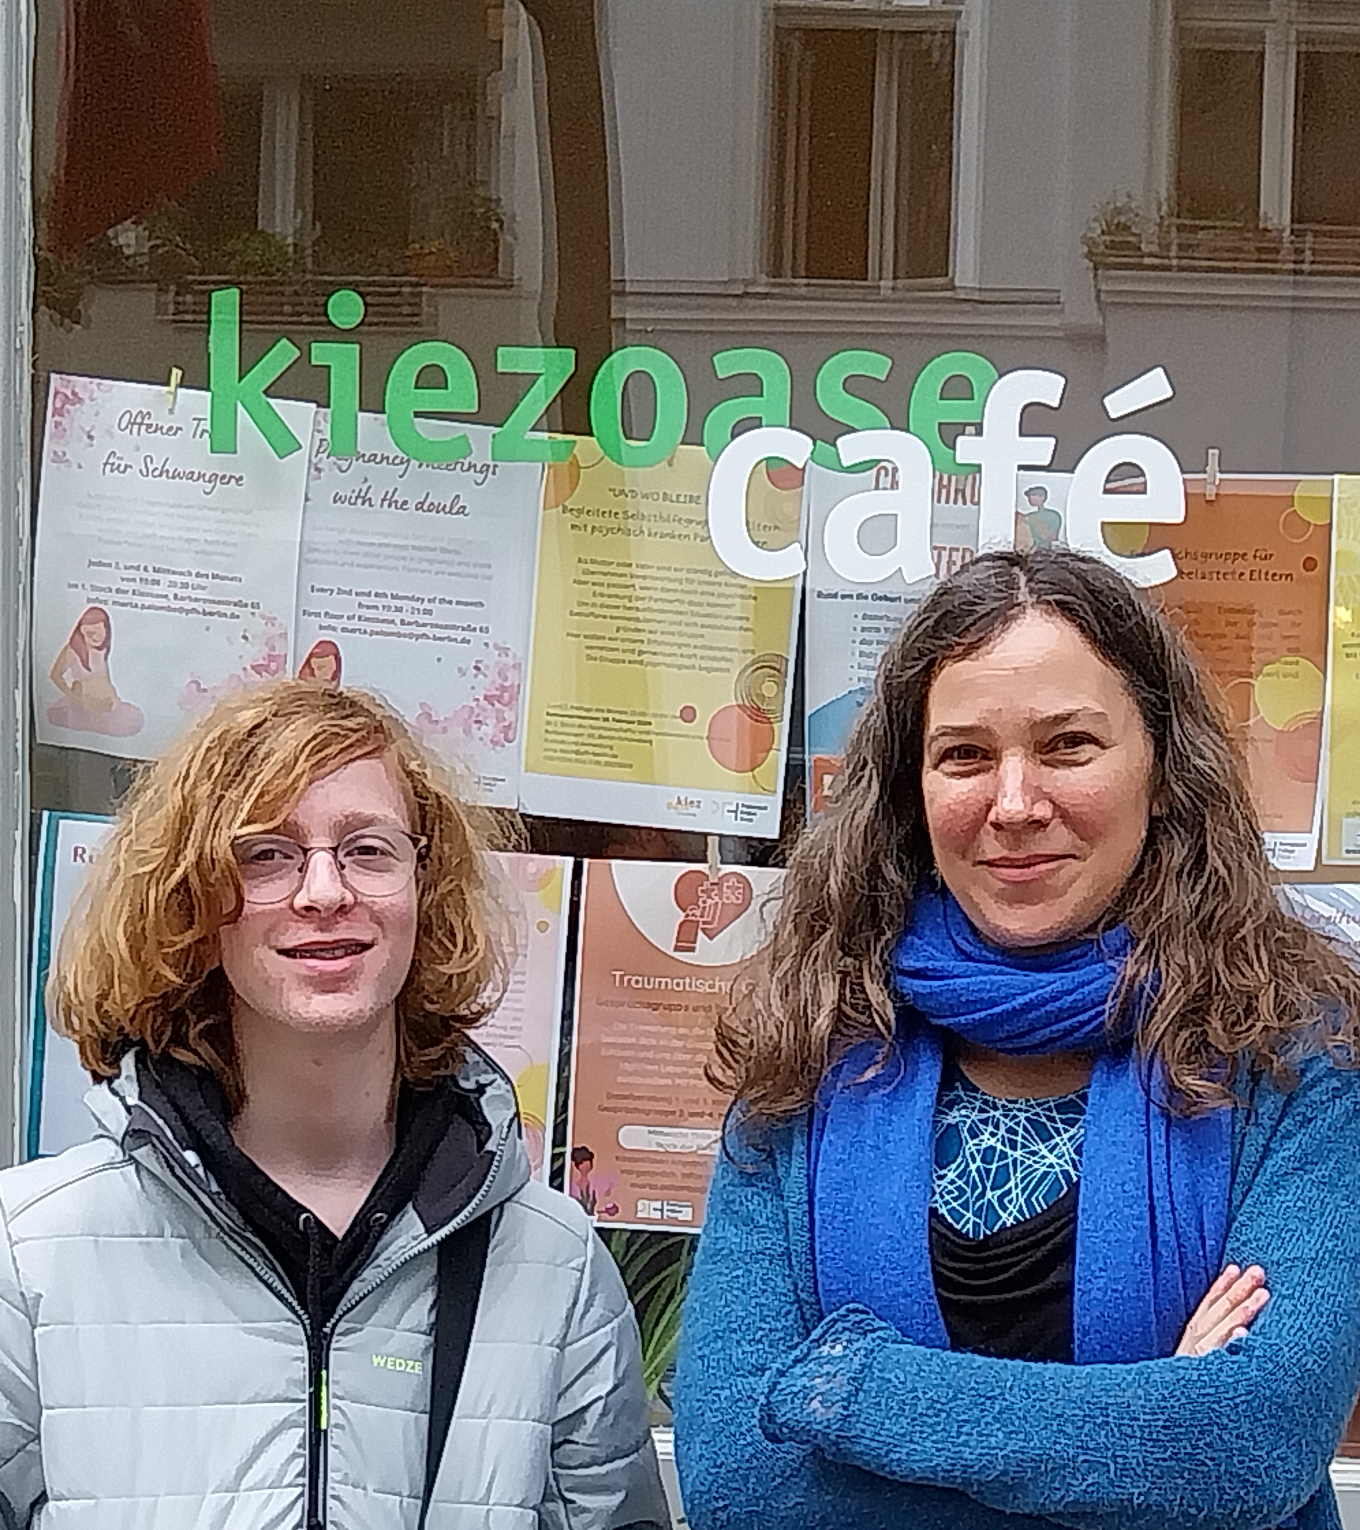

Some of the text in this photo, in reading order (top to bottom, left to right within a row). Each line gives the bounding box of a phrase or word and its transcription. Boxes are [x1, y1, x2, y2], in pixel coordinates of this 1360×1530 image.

[208, 288, 996, 476] kiezoase
[117, 409, 183, 437] Offener
[102, 451, 244, 495] für Schwangere
[706, 364, 1188, 589] café
[333, 484, 470, 516] with the doula
[562, 504, 619, 521] Begleitete
[571, 524, 587, 532] mit
[591, 524, 645, 538] psychisch
[1252, 549, 1275, 561] für
[1249, 570, 1294, 583] Eltern
[372, 1355, 422, 1374] WEDZE
